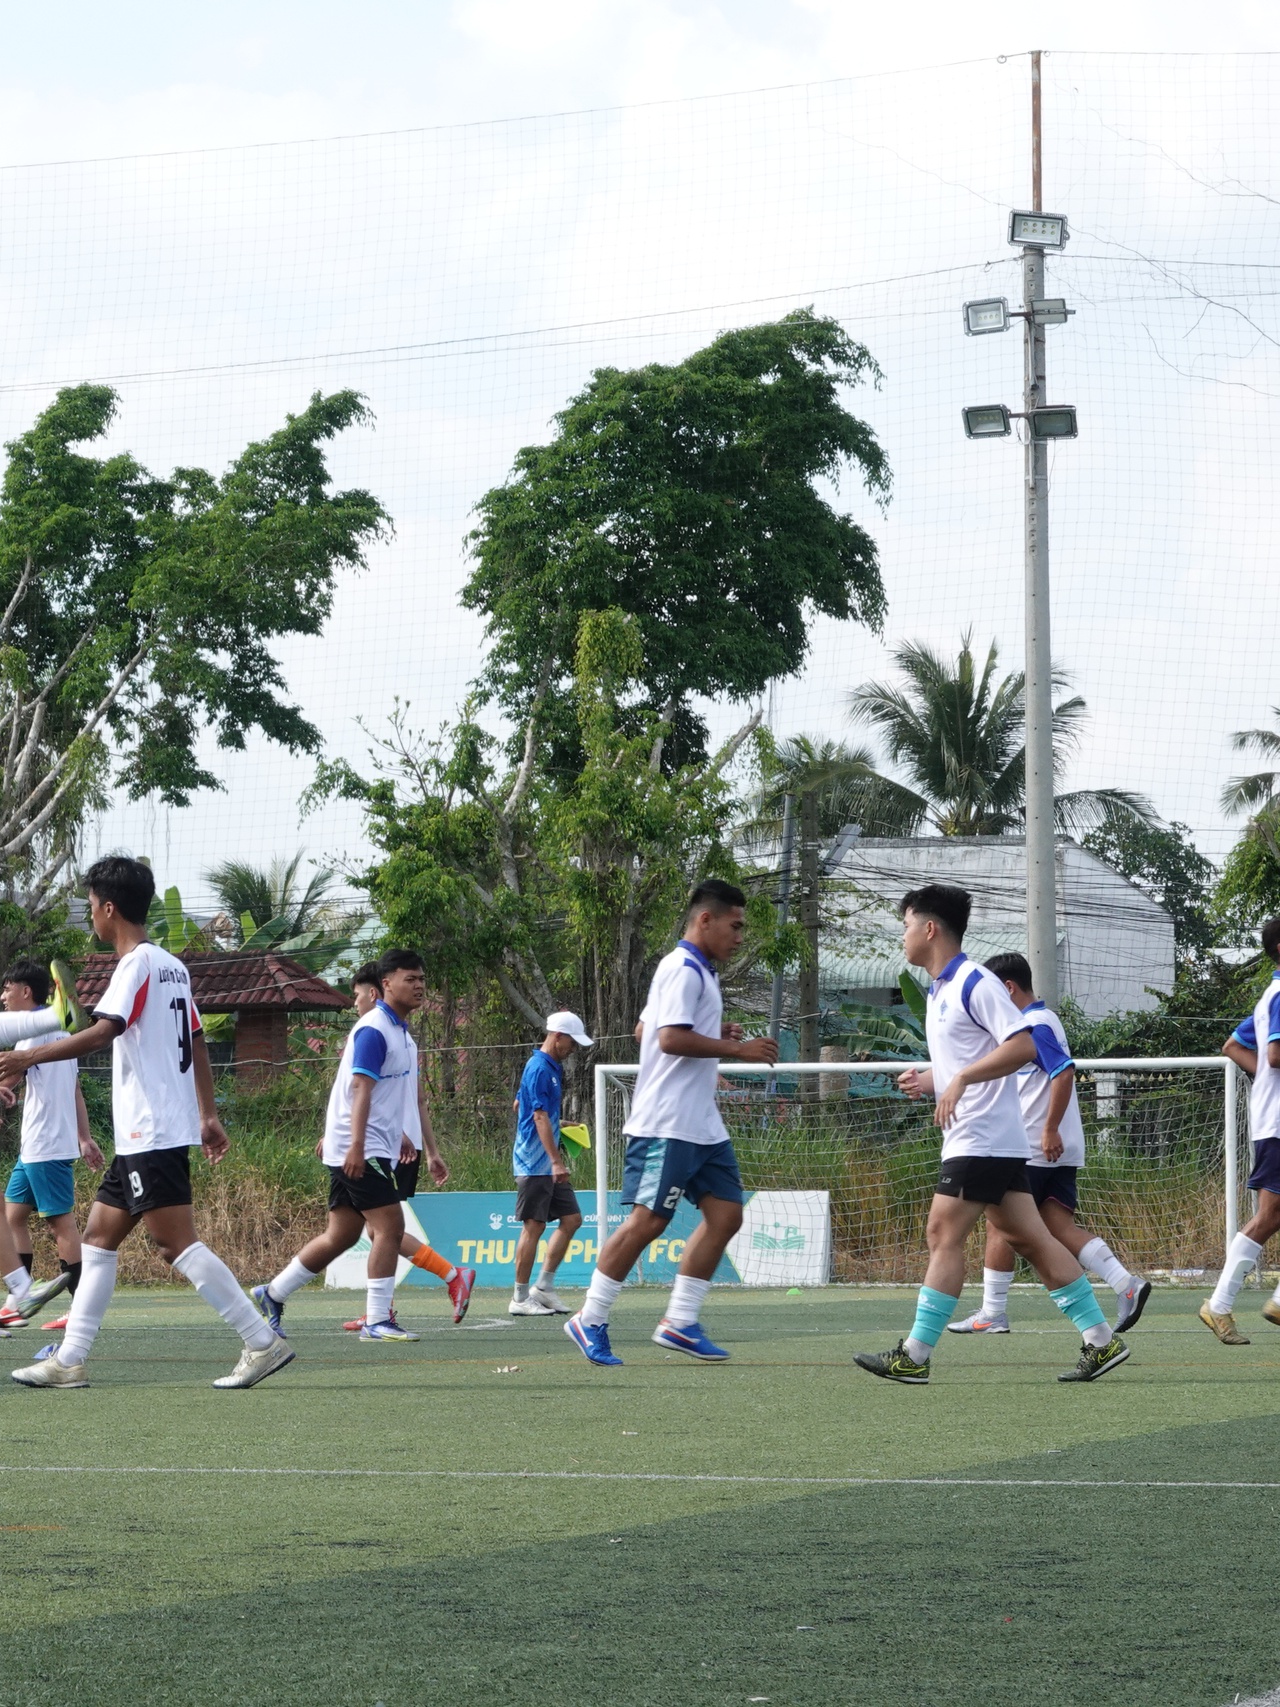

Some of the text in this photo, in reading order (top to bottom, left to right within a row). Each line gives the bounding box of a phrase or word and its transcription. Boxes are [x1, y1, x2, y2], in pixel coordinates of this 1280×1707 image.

[663, 1186, 685, 1210] 2
[457, 1239, 549, 1263] THUN
[648, 1239, 687, 1263] FC
